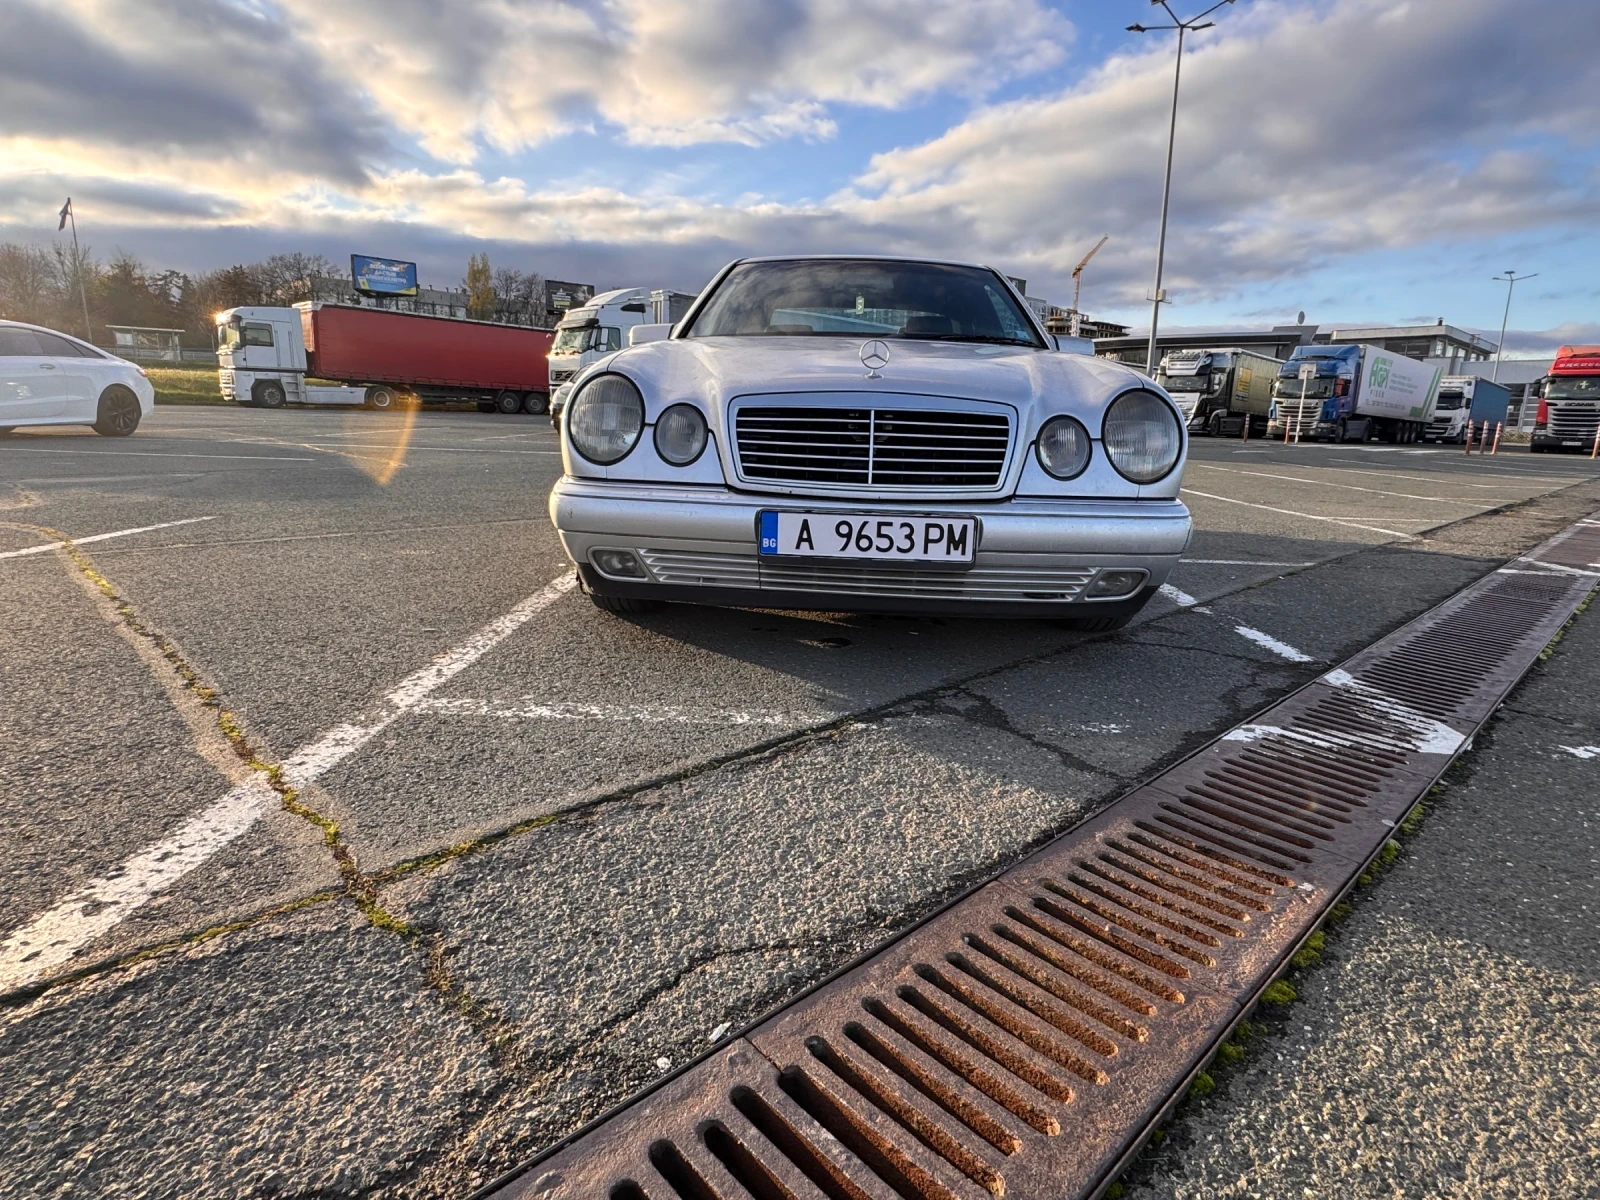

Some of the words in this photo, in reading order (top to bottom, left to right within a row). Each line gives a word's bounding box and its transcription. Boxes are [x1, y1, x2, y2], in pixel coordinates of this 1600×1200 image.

[762, 537, 776, 548] BG
[795, 518, 815, 551] A
[834, 519, 916, 554] 9653
[922, 522, 969, 556] PM
